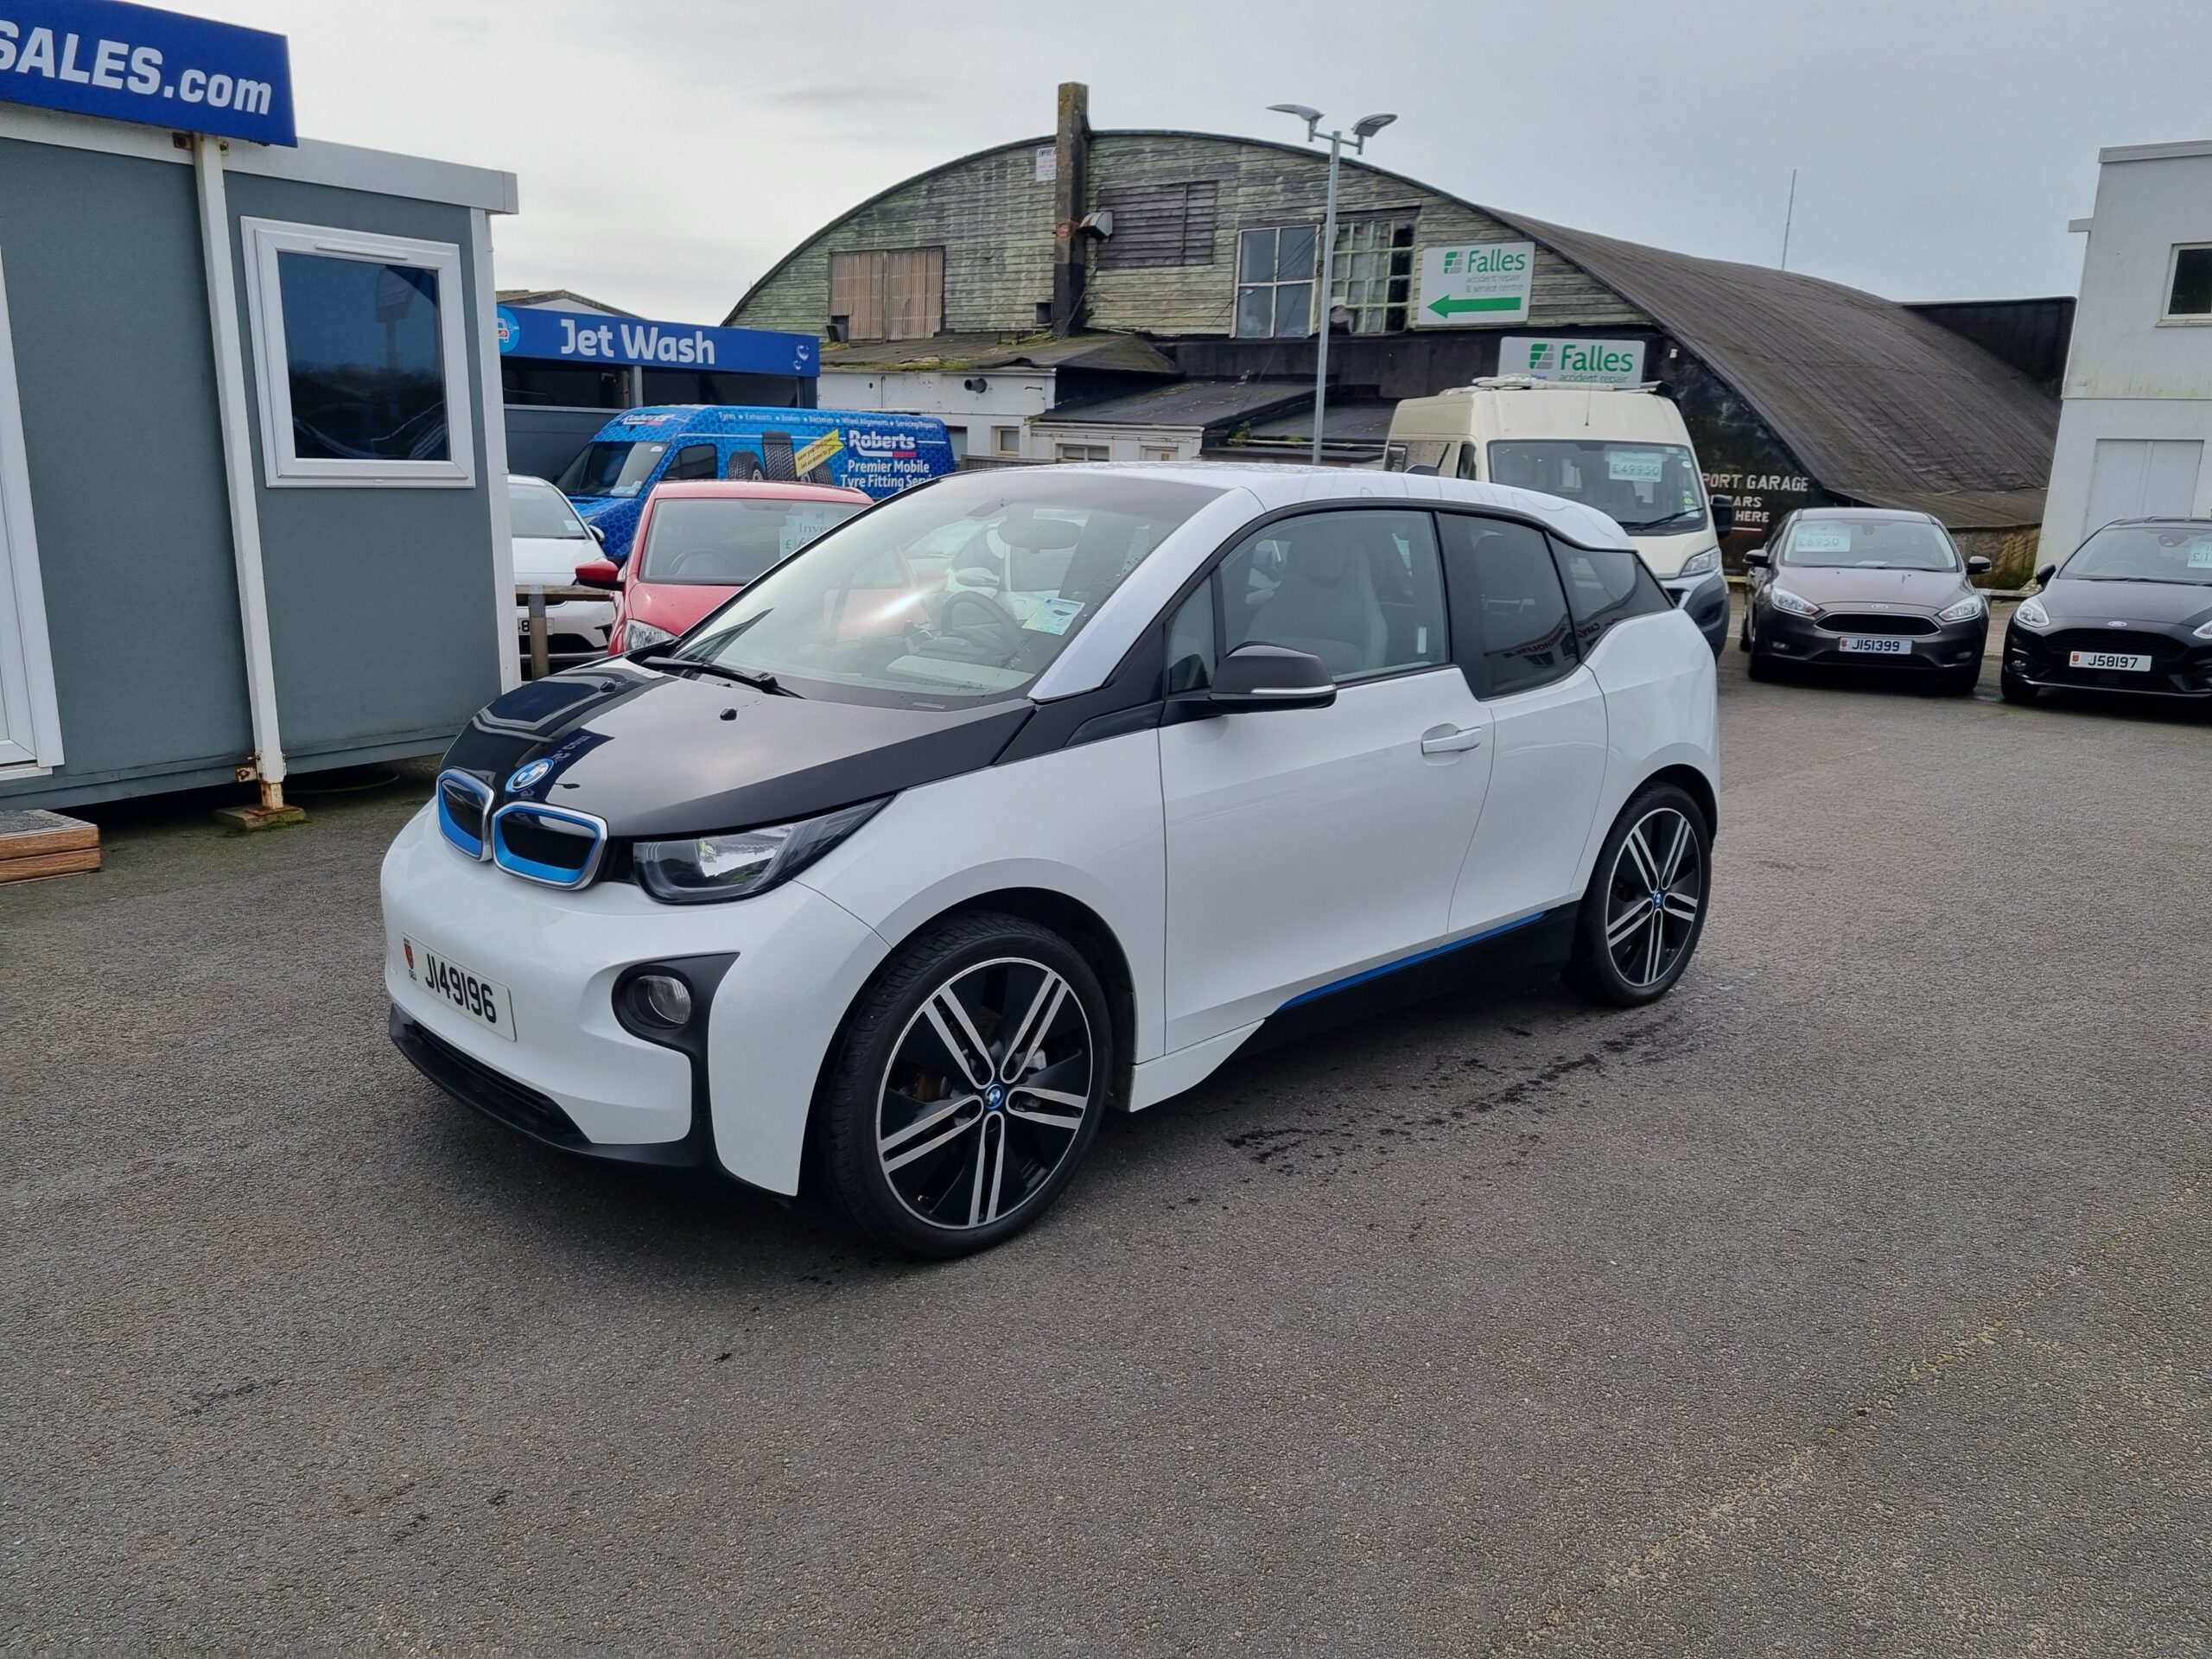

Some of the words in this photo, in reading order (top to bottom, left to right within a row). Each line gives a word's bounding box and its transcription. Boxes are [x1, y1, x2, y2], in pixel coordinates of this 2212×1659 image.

[0, 20, 272, 115] SALES.com
[1467, 249, 1526, 273] Falles
[560, 319, 614, 358] Jet
[620, 323, 716, 365] Wash
[1560, 344, 1634, 372] Falles
[1559, 372, 1597, 383] accident
[718, 411, 736, 422] Tyres
[746, 412, 772, 421] Exhausts
[781, 414, 801, 423] Brakes
[809, 415, 835, 424] Batteries
[860, 417, 889, 428] Alignments
[849, 429, 916, 449] Roberts
[848, 460, 892, 474] Premier
[893, 459, 931, 474] Mobile
[840, 474, 867, 488] Tyre
[868, 473, 905, 489] Fitting
[1746, 474, 1809, 493] GARAGE
[1732, 495, 1763, 508] ARS
[1735, 509, 1770, 523] HERE
[1852, 639, 1900, 652] J151399
[2088, 655, 2139, 669] J58197
[424, 953, 498, 1024] J149196
